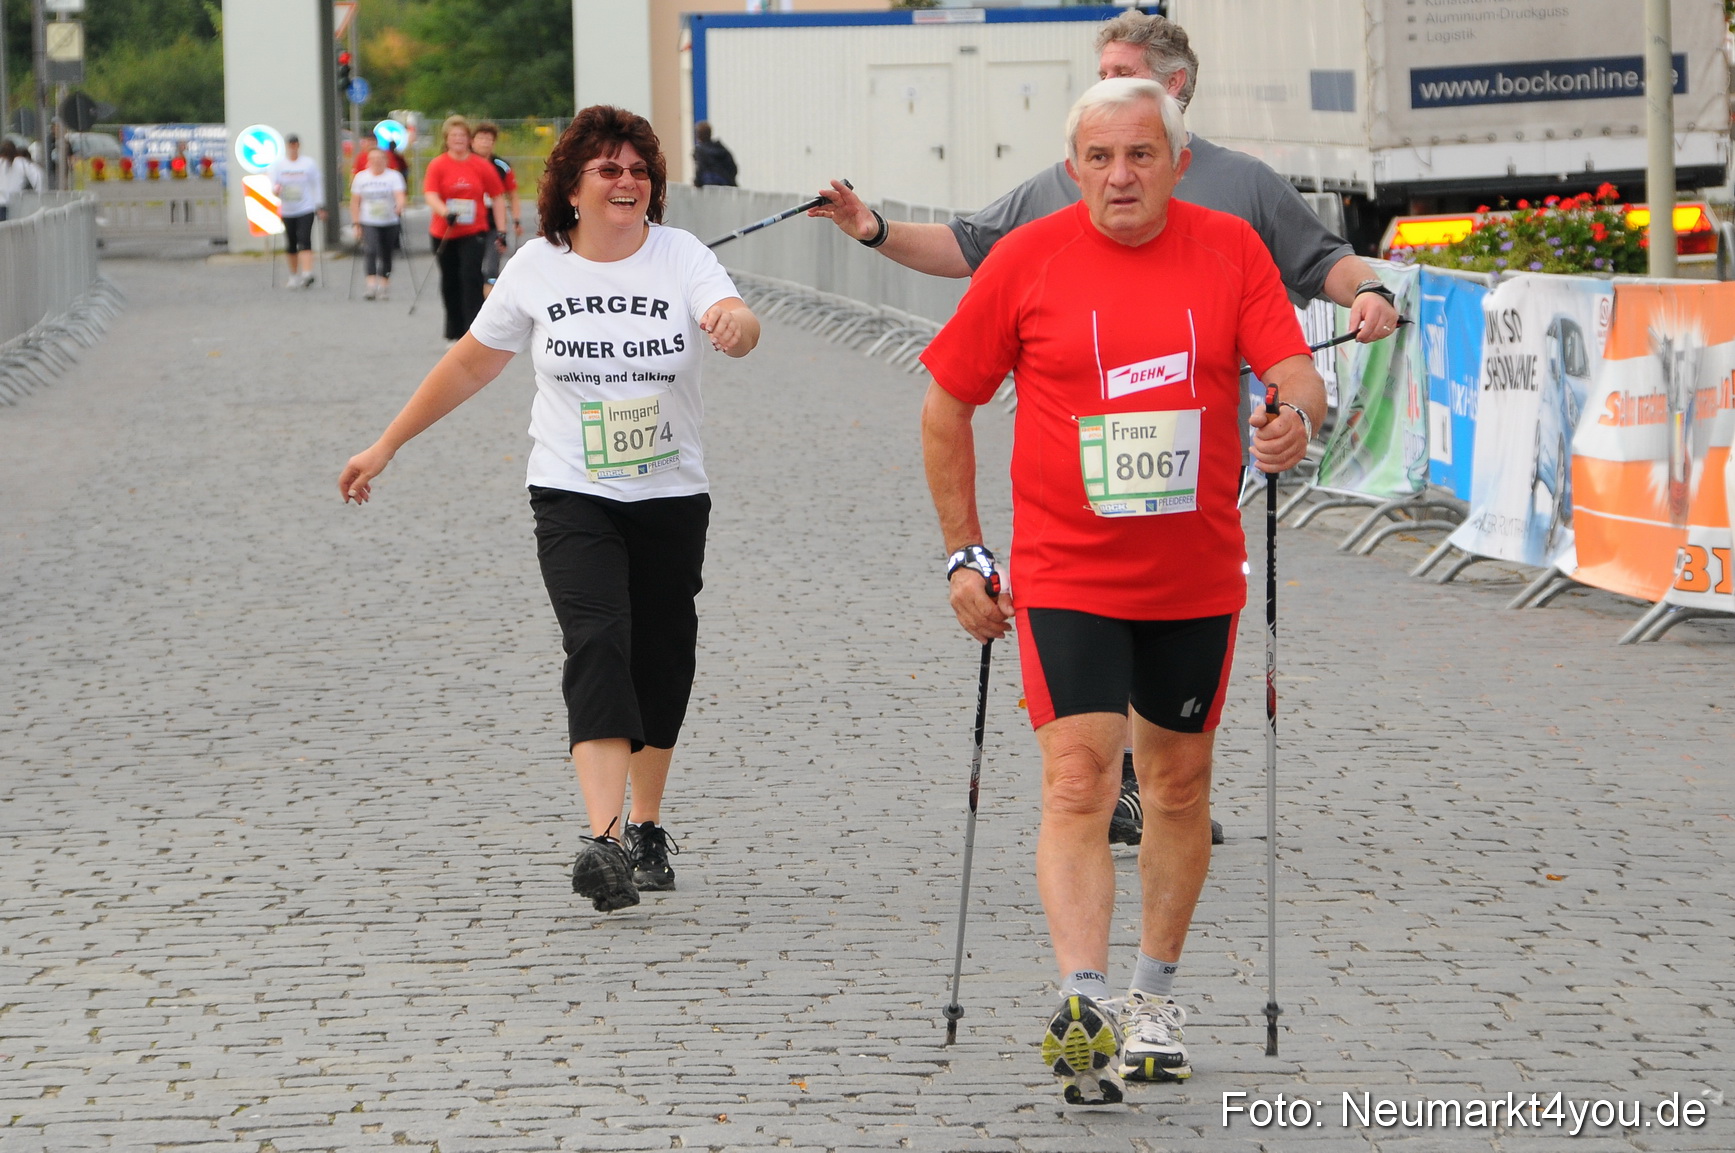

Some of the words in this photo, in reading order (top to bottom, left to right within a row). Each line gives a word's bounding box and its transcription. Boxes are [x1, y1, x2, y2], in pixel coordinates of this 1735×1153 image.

[1426, 6, 1569, 25] Aluminium-Druckguss
[1426, 28, 1476, 43] Logistik
[1419, 66, 1679, 101] www.bockonline.e
[546, 295, 670, 322] BERGER
[545, 336, 615, 359] POWER
[622, 333, 685, 358] GIRLS
[554, 371, 601, 385] walking
[605, 371, 628, 383] and
[632, 371, 676, 385] talking
[1130, 365, 1165, 384] DEHN
[608, 400, 660, 423] Irmgard
[613, 421, 673, 453] 8074
[1112, 421, 1157, 441] Franz
[1116, 450, 1190, 481] 8067
[1158, 495, 1194, 507] PFLEIDERER
[1075, 972, 1106, 984] SOCKS
